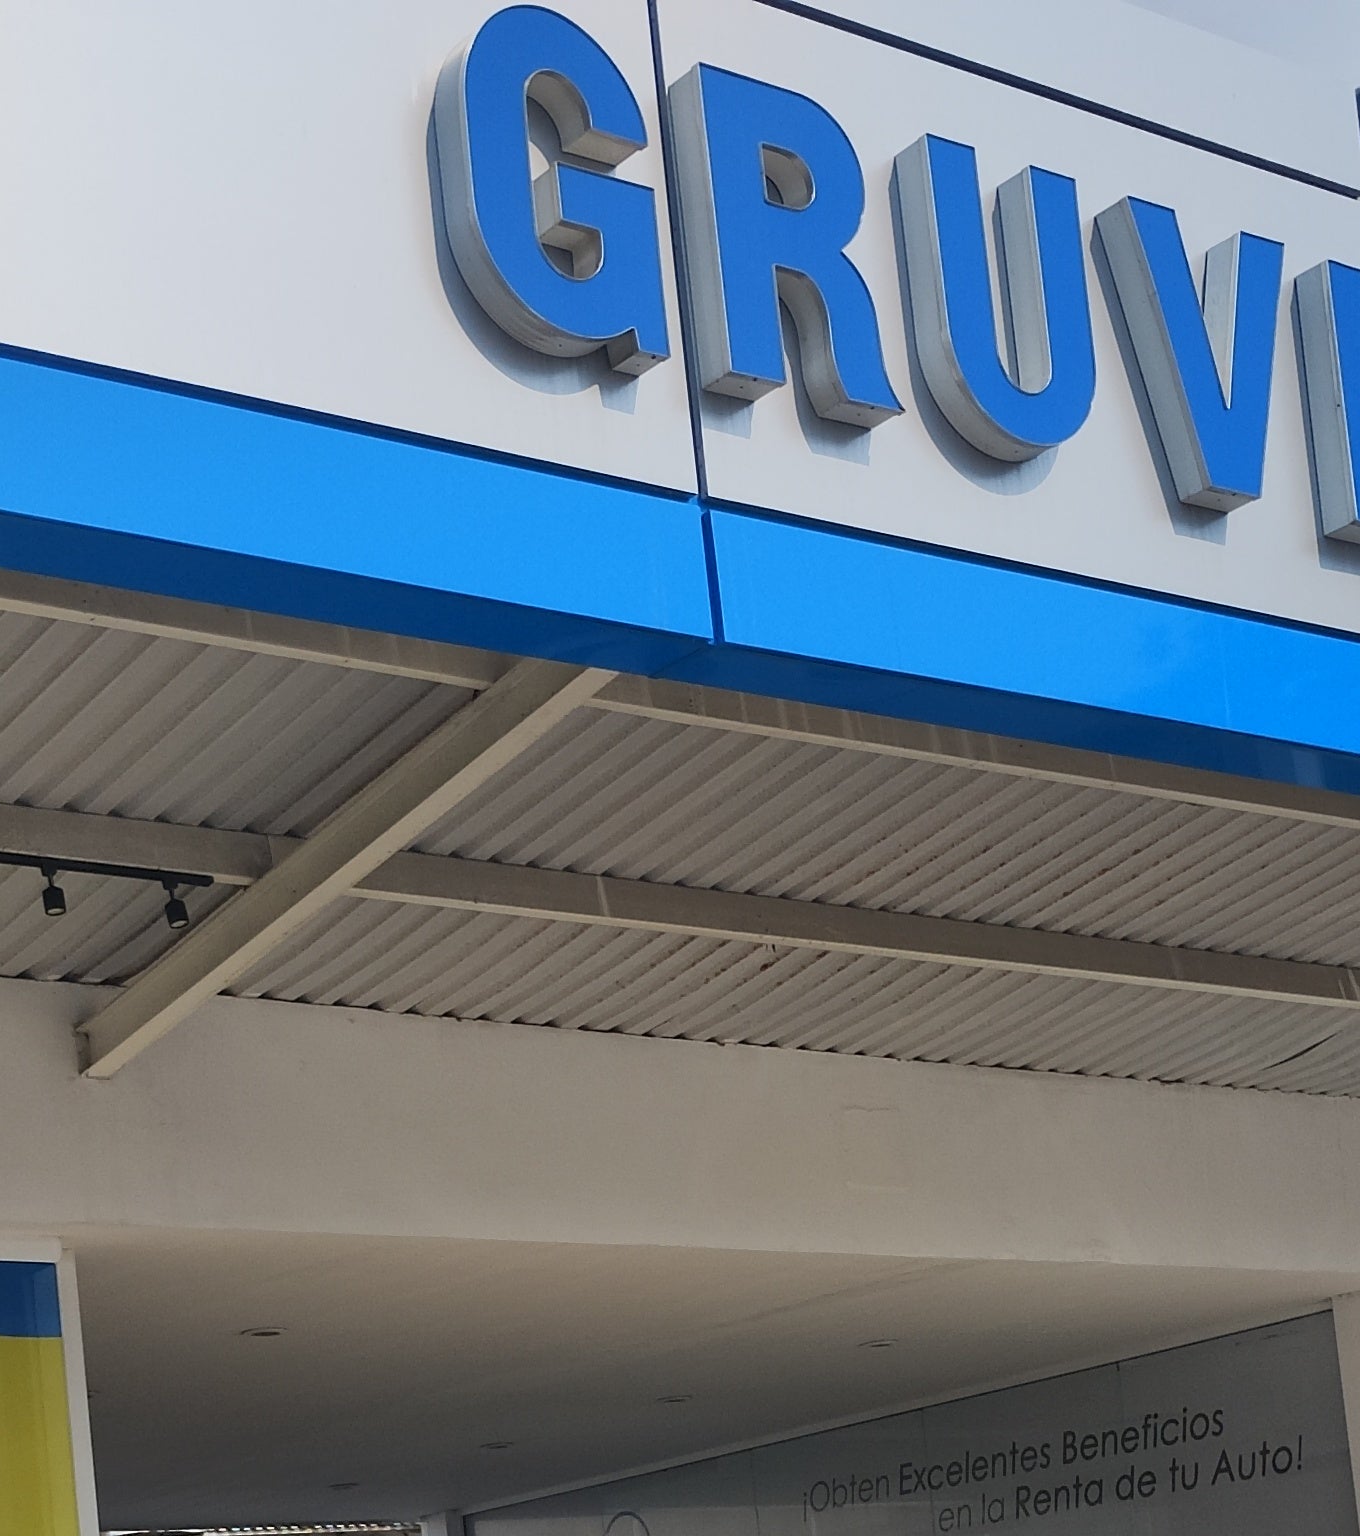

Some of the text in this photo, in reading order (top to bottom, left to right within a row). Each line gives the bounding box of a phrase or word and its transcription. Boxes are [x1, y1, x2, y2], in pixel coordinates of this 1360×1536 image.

[802, 1406, 1224, 1523] ¡Obten Excelentes Beneficios
[938, 1433, 1303, 1533] en la Renta de tu Auto!
